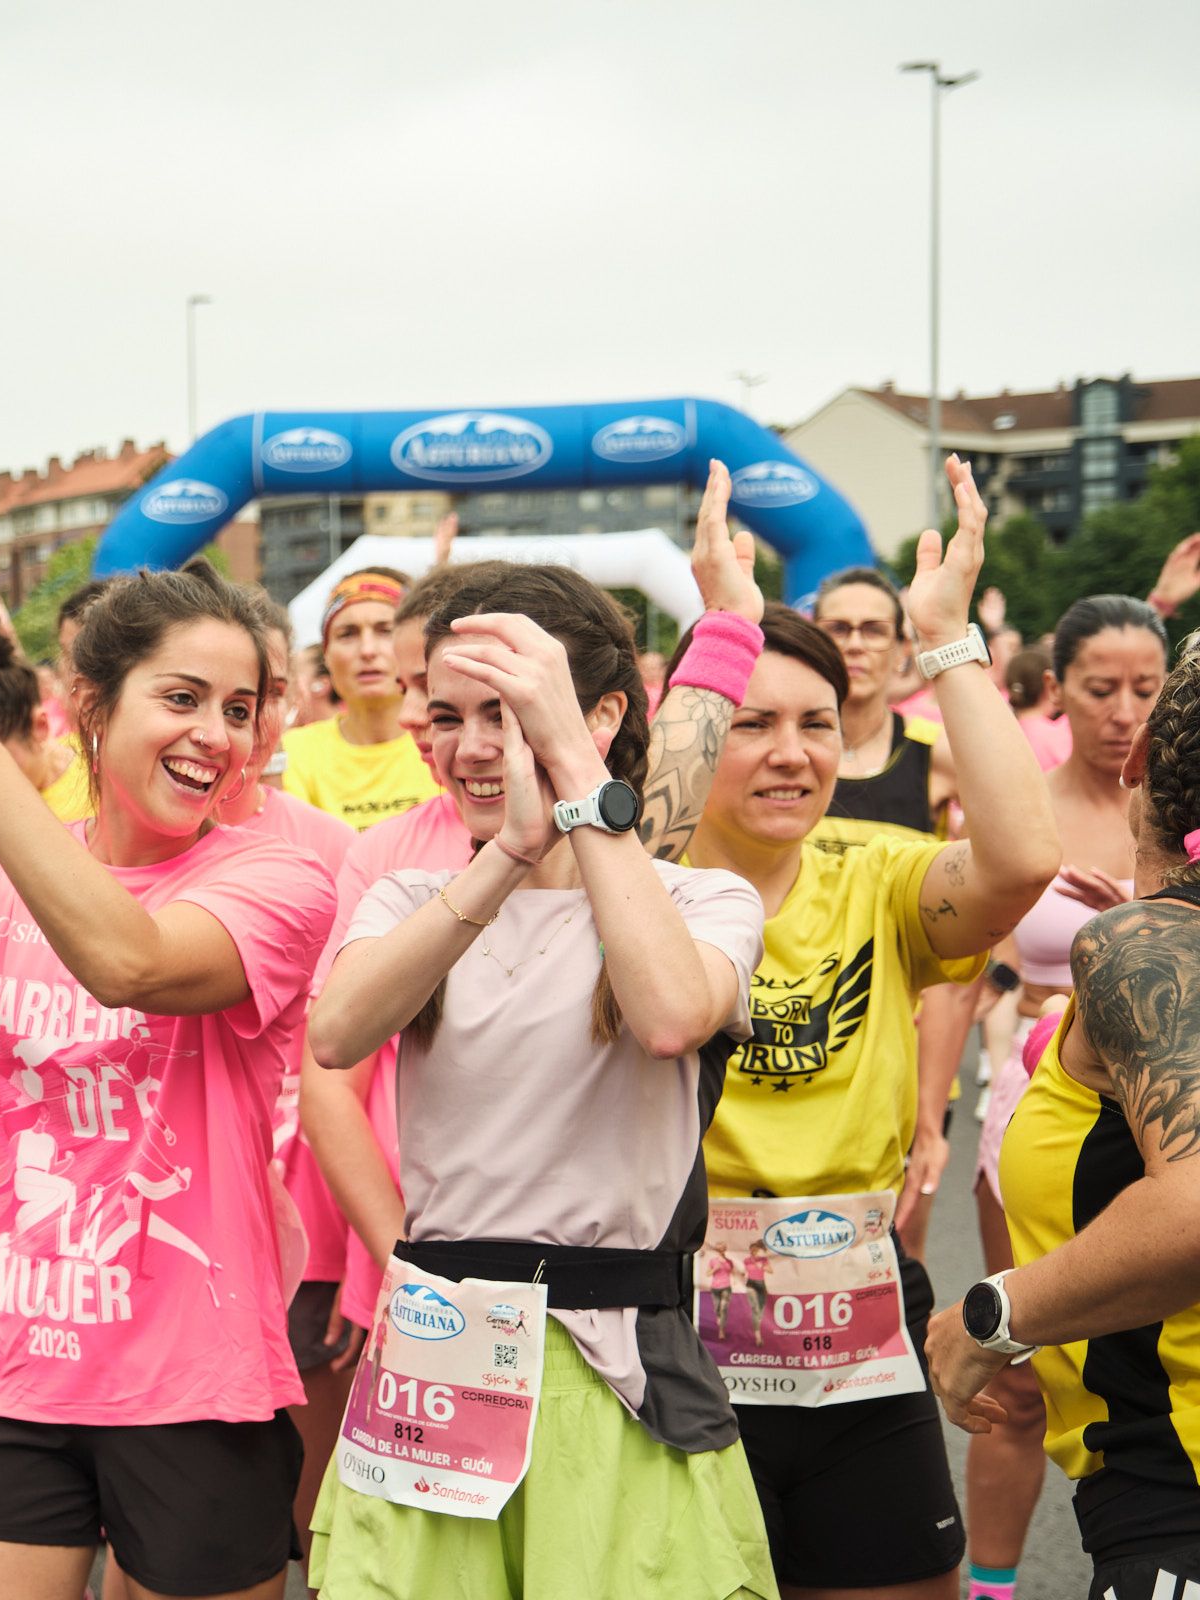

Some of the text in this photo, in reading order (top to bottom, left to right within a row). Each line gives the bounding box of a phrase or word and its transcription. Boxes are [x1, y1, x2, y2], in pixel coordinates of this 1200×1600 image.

[753, 997, 808, 1021] BORN
[772, 1022, 794, 1044] TO
[749, 1045, 822, 1070] RUN
[61, 1064, 130, 1141] DE
[57, 1184, 103, 1260] LA
[714, 1218, 759, 1230] SUMA
[773, 1229, 849, 1247] ASTURIANA
[392, 1297, 456, 1332] ASTURIANA
[773, 1291, 853, 1329] 016
[29, 1324, 81, 1361] 2026
[803, 1336, 832, 1351] 618
[729, 1352, 783, 1366] CARRERA
[786, 1352, 801, 1366] DE
[804, 1354, 819, 1367] LA
[378, 1372, 455, 1422] 016
[725, 1377, 796, 1393] OYSHO
[394, 1423, 424, 1444] 812
[343, 1451, 386, 1484] OYSHO
[377, 1440, 392, 1454] DE
[395, 1445, 409, 1458] LA
[412, 1447, 451, 1467] MUJER
[461, 1454, 493, 1475] GIJÓN
[432, 1482, 492, 1506] Santander
